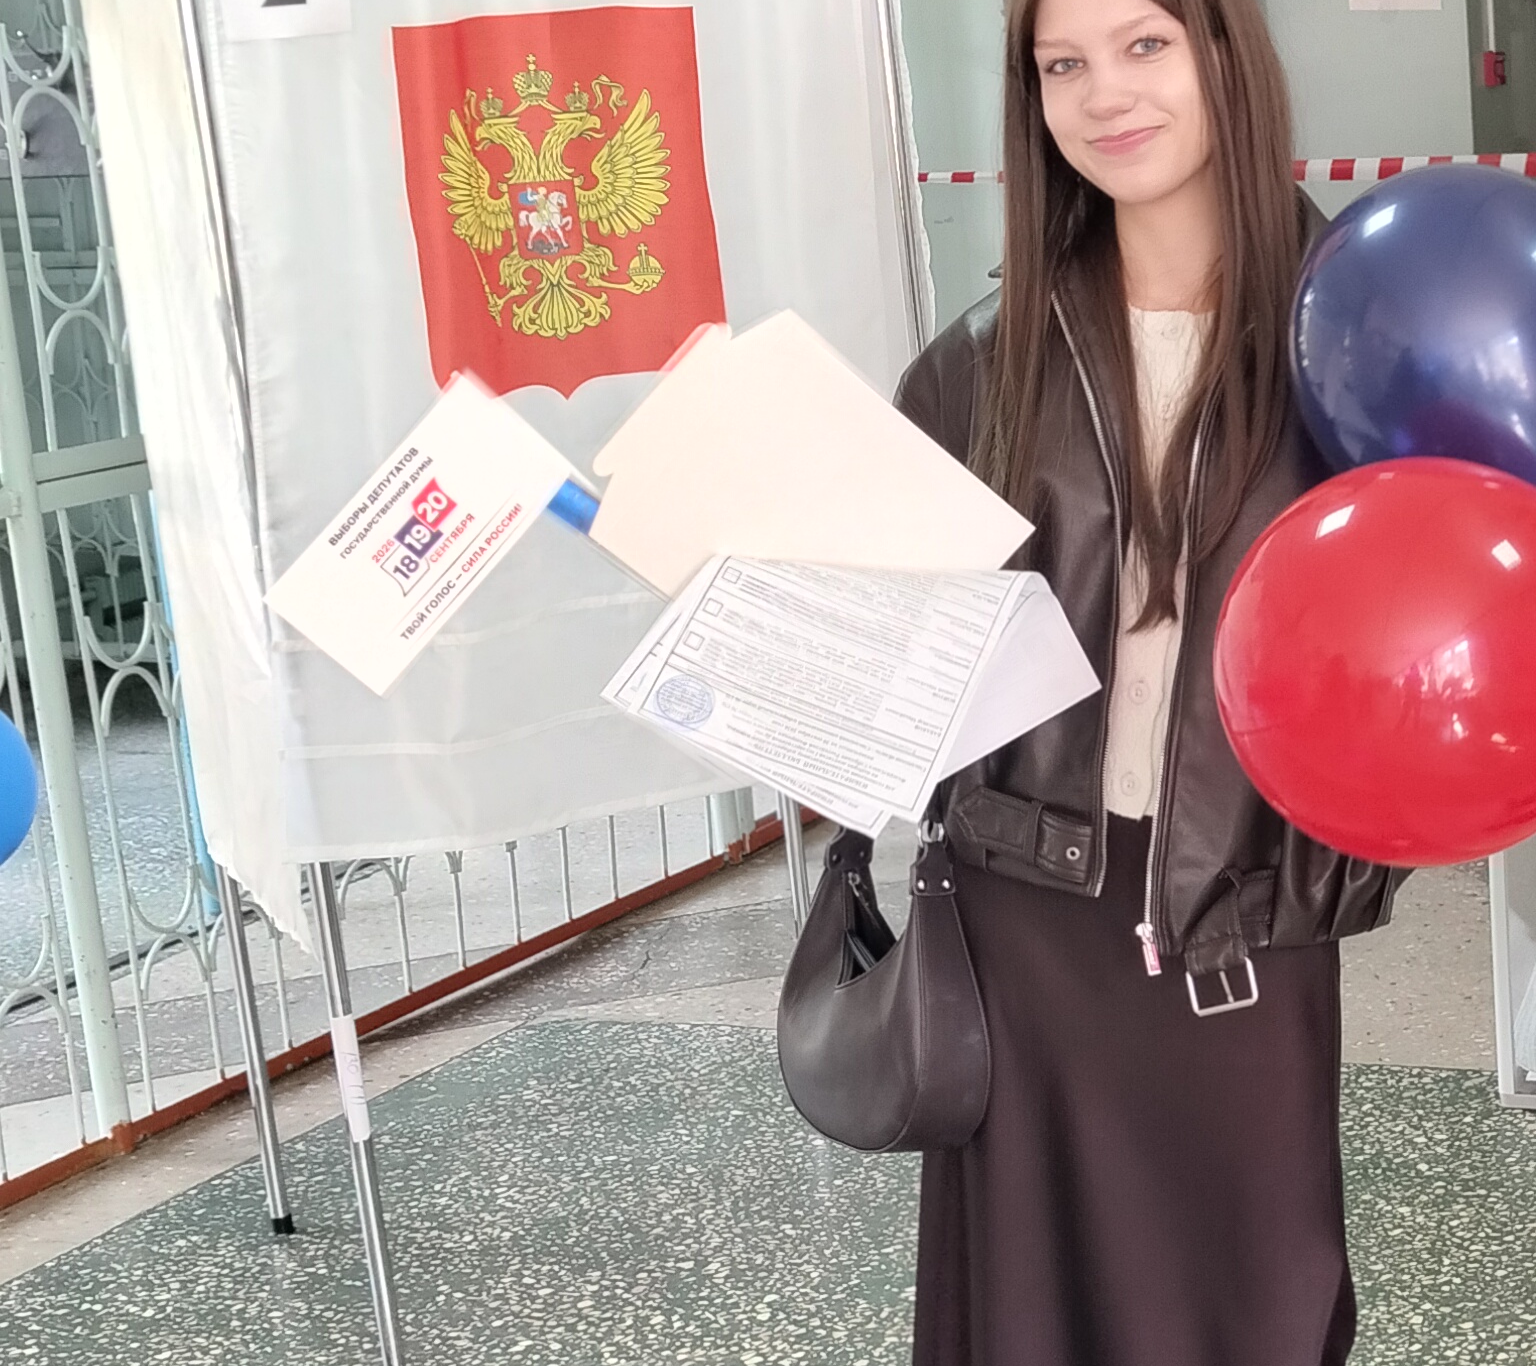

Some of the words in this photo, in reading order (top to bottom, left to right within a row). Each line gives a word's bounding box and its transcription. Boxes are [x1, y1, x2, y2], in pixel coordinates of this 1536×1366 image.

[328, 502, 370, 546] ВЫБОРЫ
[366, 447, 419, 505] ДЕПУТАТОВ
[339, 480, 411, 559] ГОСУДАРСТВЕННОЙ
[409, 456, 434, 484] ДУМЫ
[416, 490, 448, 525] 20
[371, 538, 396, 564] 2026
[403, 524, 431, 551] 19
[428, 512, 475, 563] СЕНТЯБРЯ
[392, 554, 420, 580] 18
[399, 611, 428, 640] ТВОЙ
[425, 579, 456, 615] ГОЛОС
[461, 545, 488, 573] СИЛА
[484, 502, 523, 546] РОССИИ!
